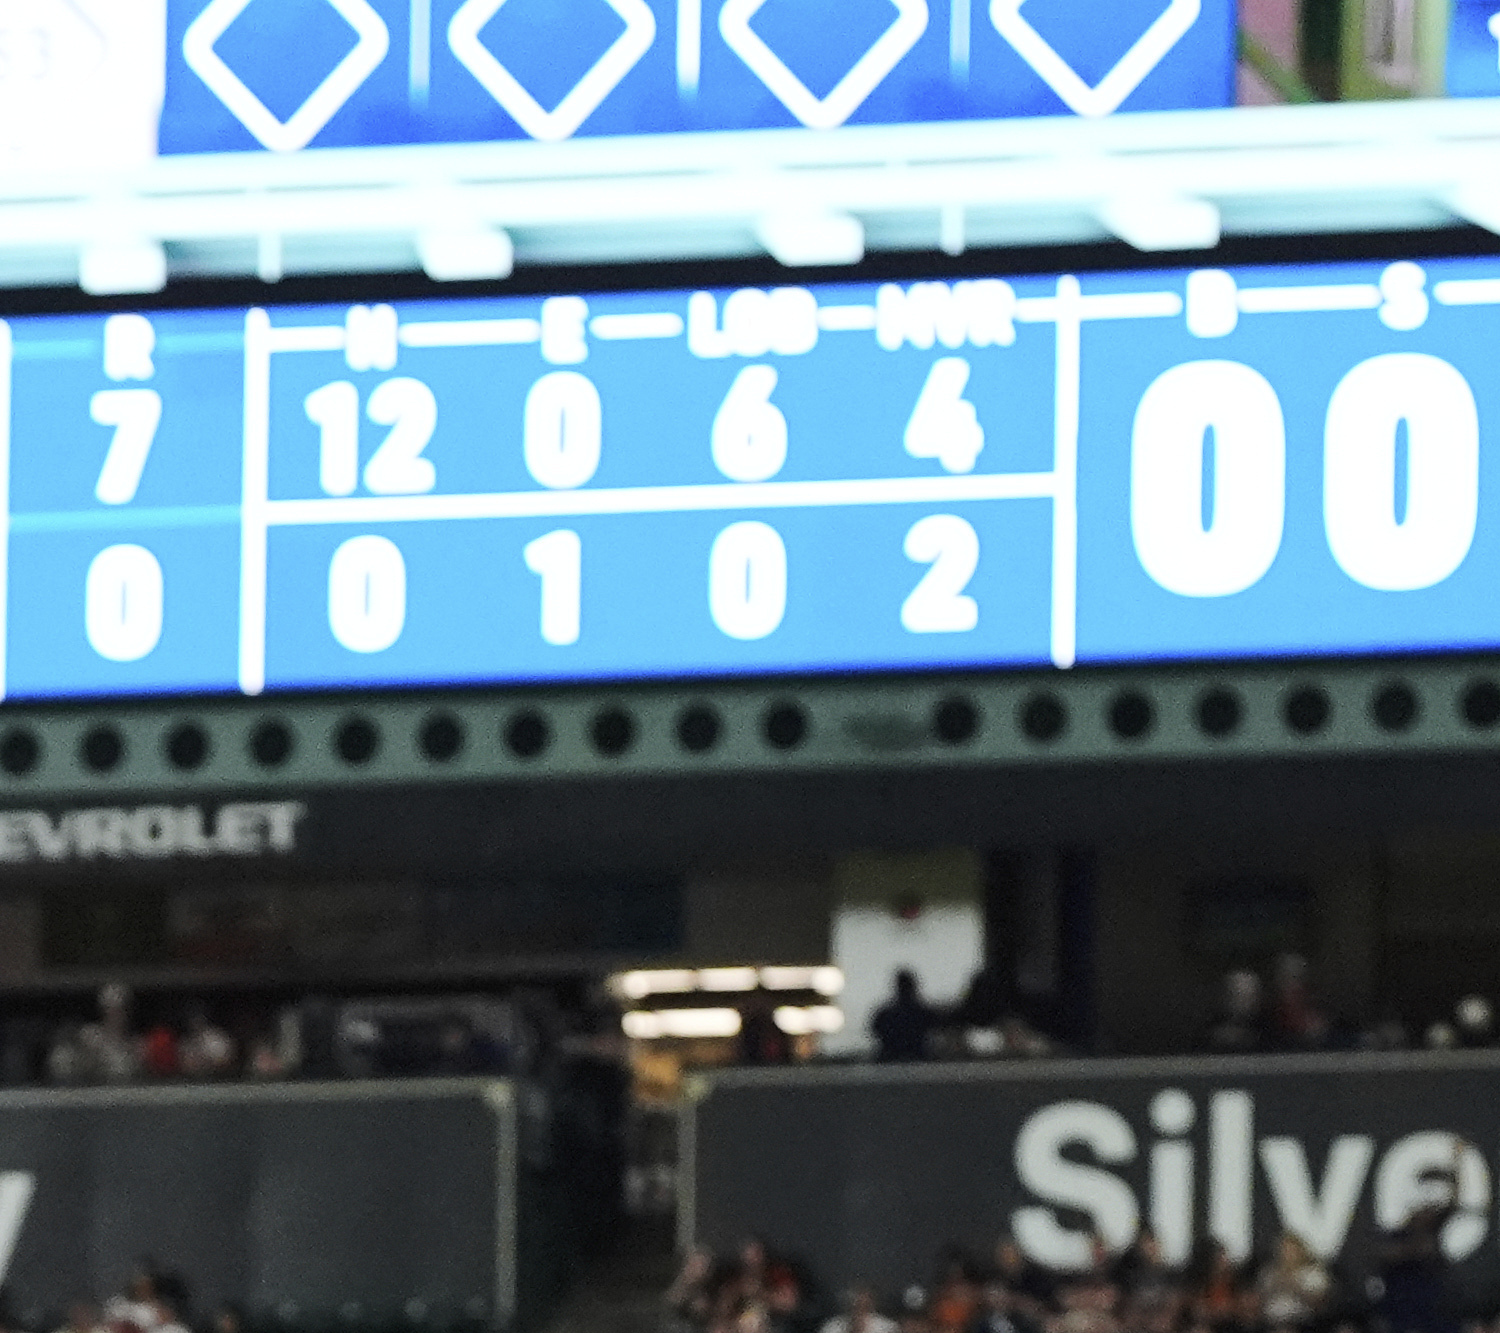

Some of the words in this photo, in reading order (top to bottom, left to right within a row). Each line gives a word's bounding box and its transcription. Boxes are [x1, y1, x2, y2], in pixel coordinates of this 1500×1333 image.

[541, 296, 589, 364] E
[1378, 260, 1429, 331] S
[89, 388, 162, 505] 7
[304, 376, 438, 496] 12
[524, 370, 602, 489] 0
[711, 364, 788, 482] 6
[903, 356, 984, 474] 4
[1131, 358, 1287, 598] 0
[1322, 352, 1480, 592] 0
[85, 543, 164, 662] 0
[328, 534, 407, 653] 0
[523, 529, 582, 646] 1
[709, 520, 788, 641] 0
[901, 513, 980, 633] 2
